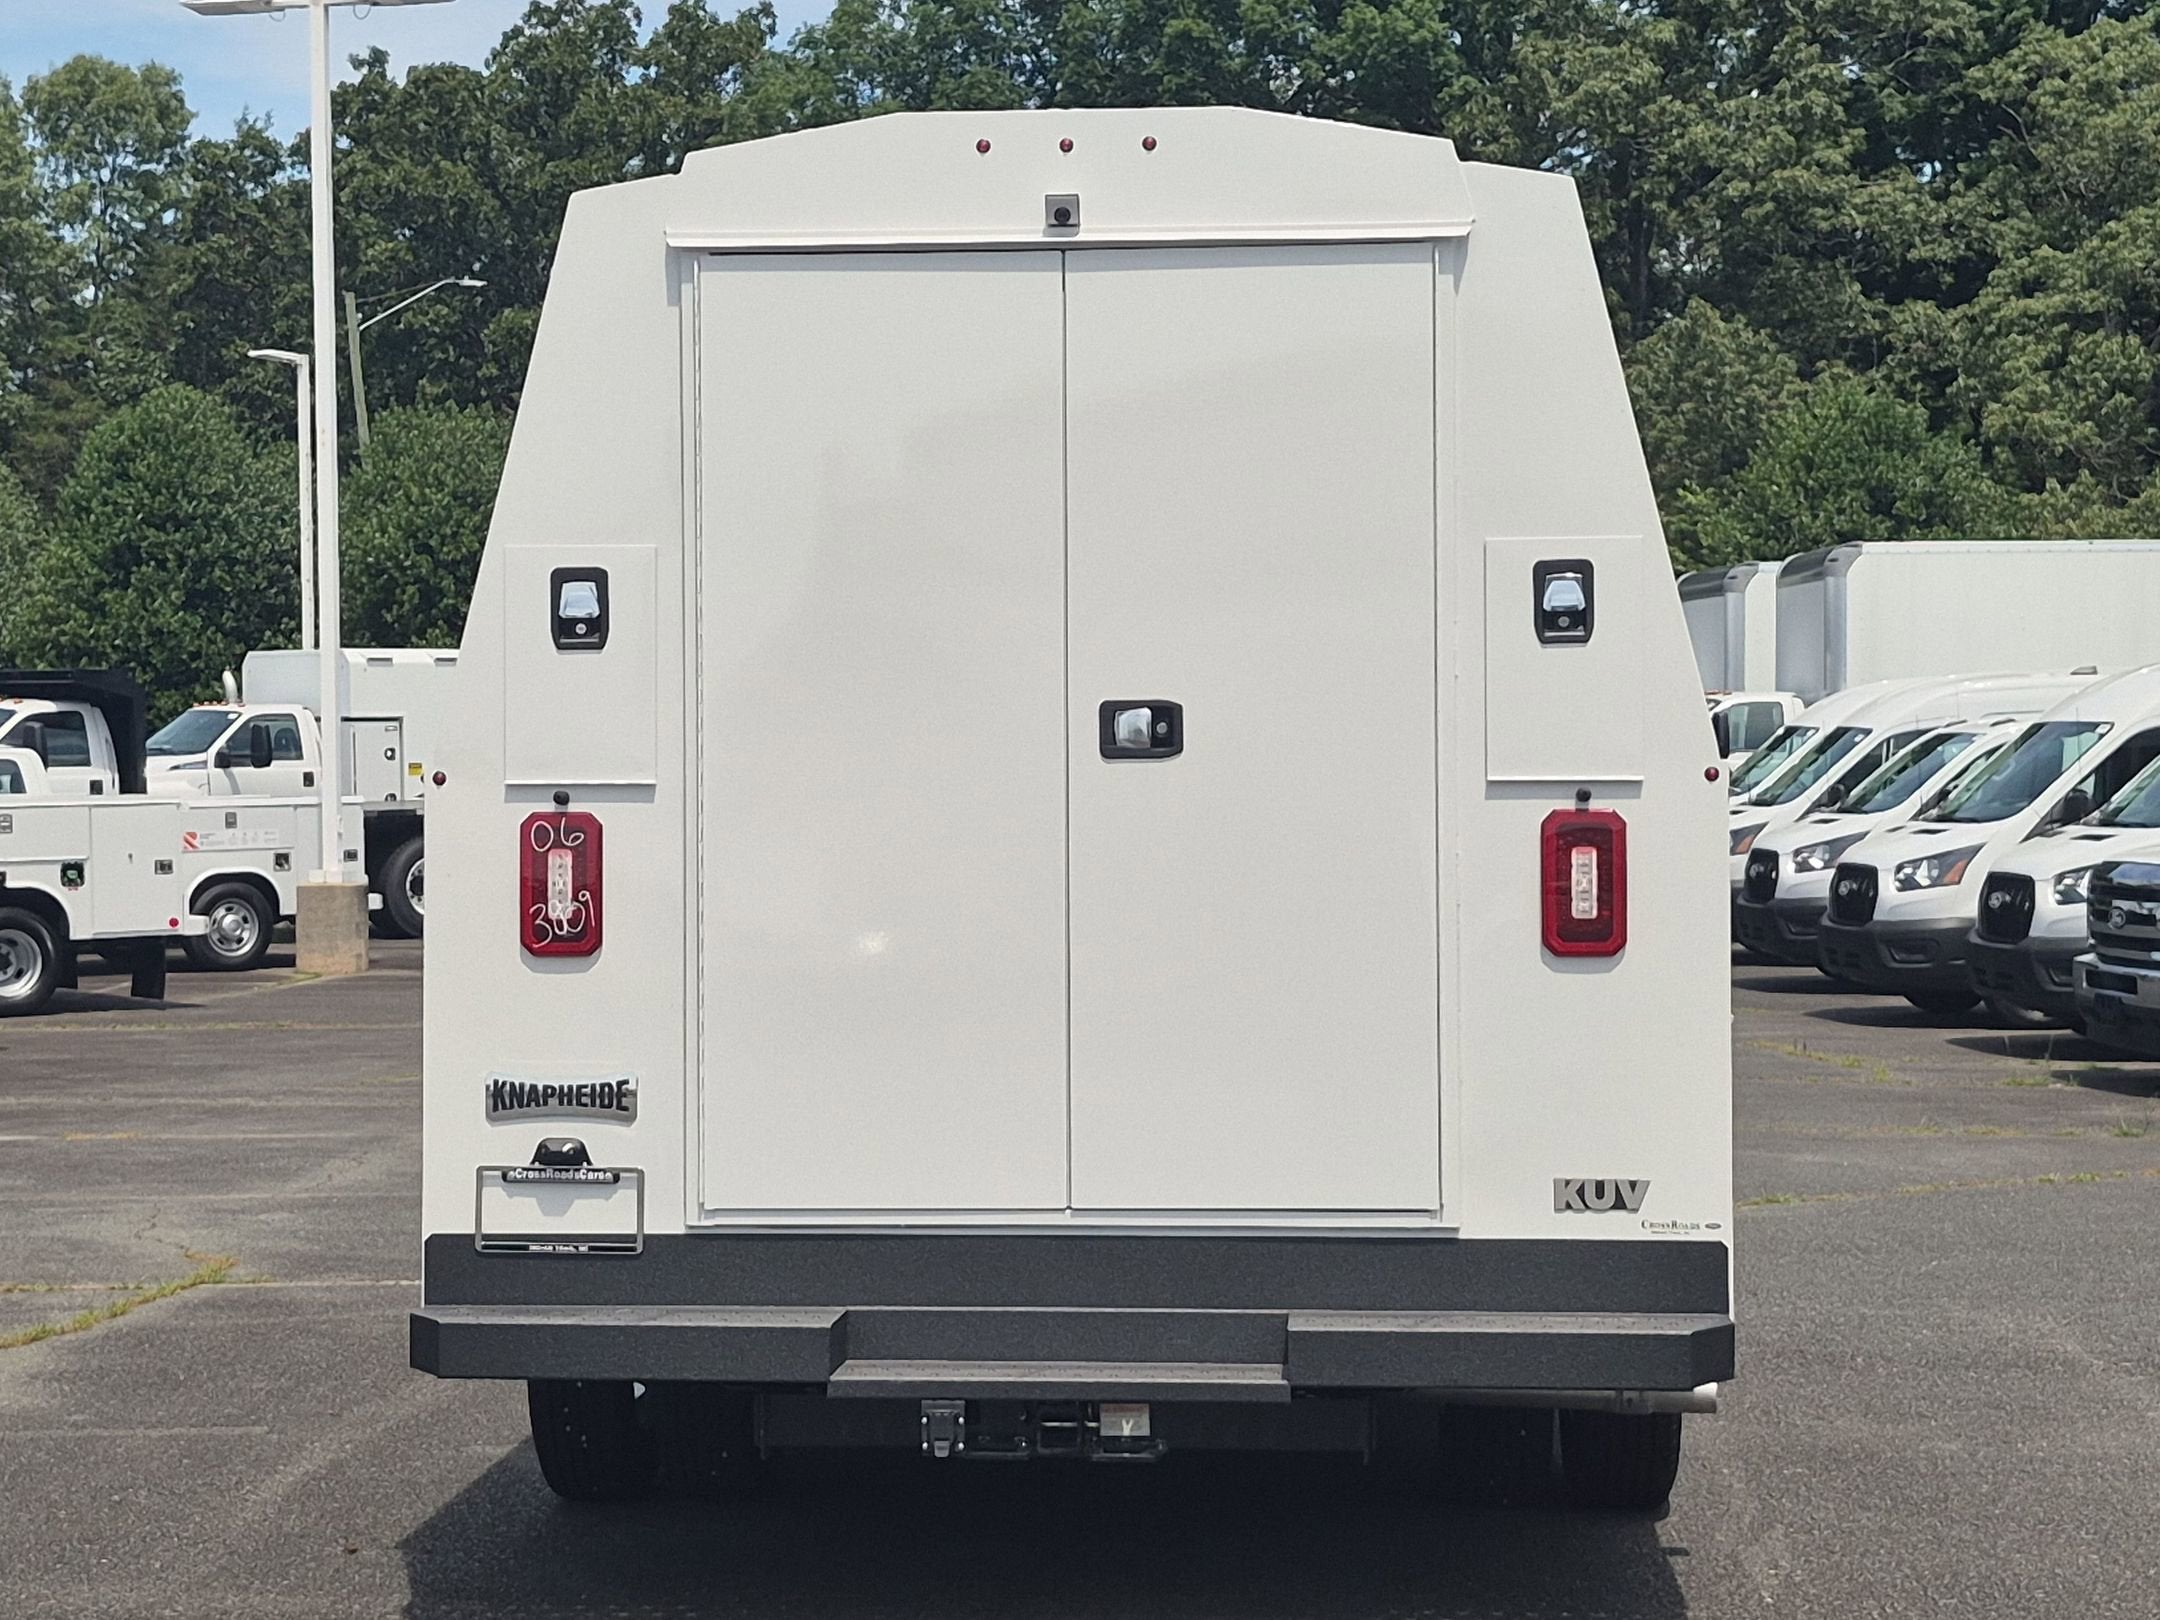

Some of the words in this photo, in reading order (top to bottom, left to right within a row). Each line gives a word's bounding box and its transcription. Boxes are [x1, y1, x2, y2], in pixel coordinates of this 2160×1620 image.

[530, 816, 585, 852] 06
[491, 1078, 630, 1113] KNAPHEIDE
[1553, 1178, 1651, 1214] KUV
